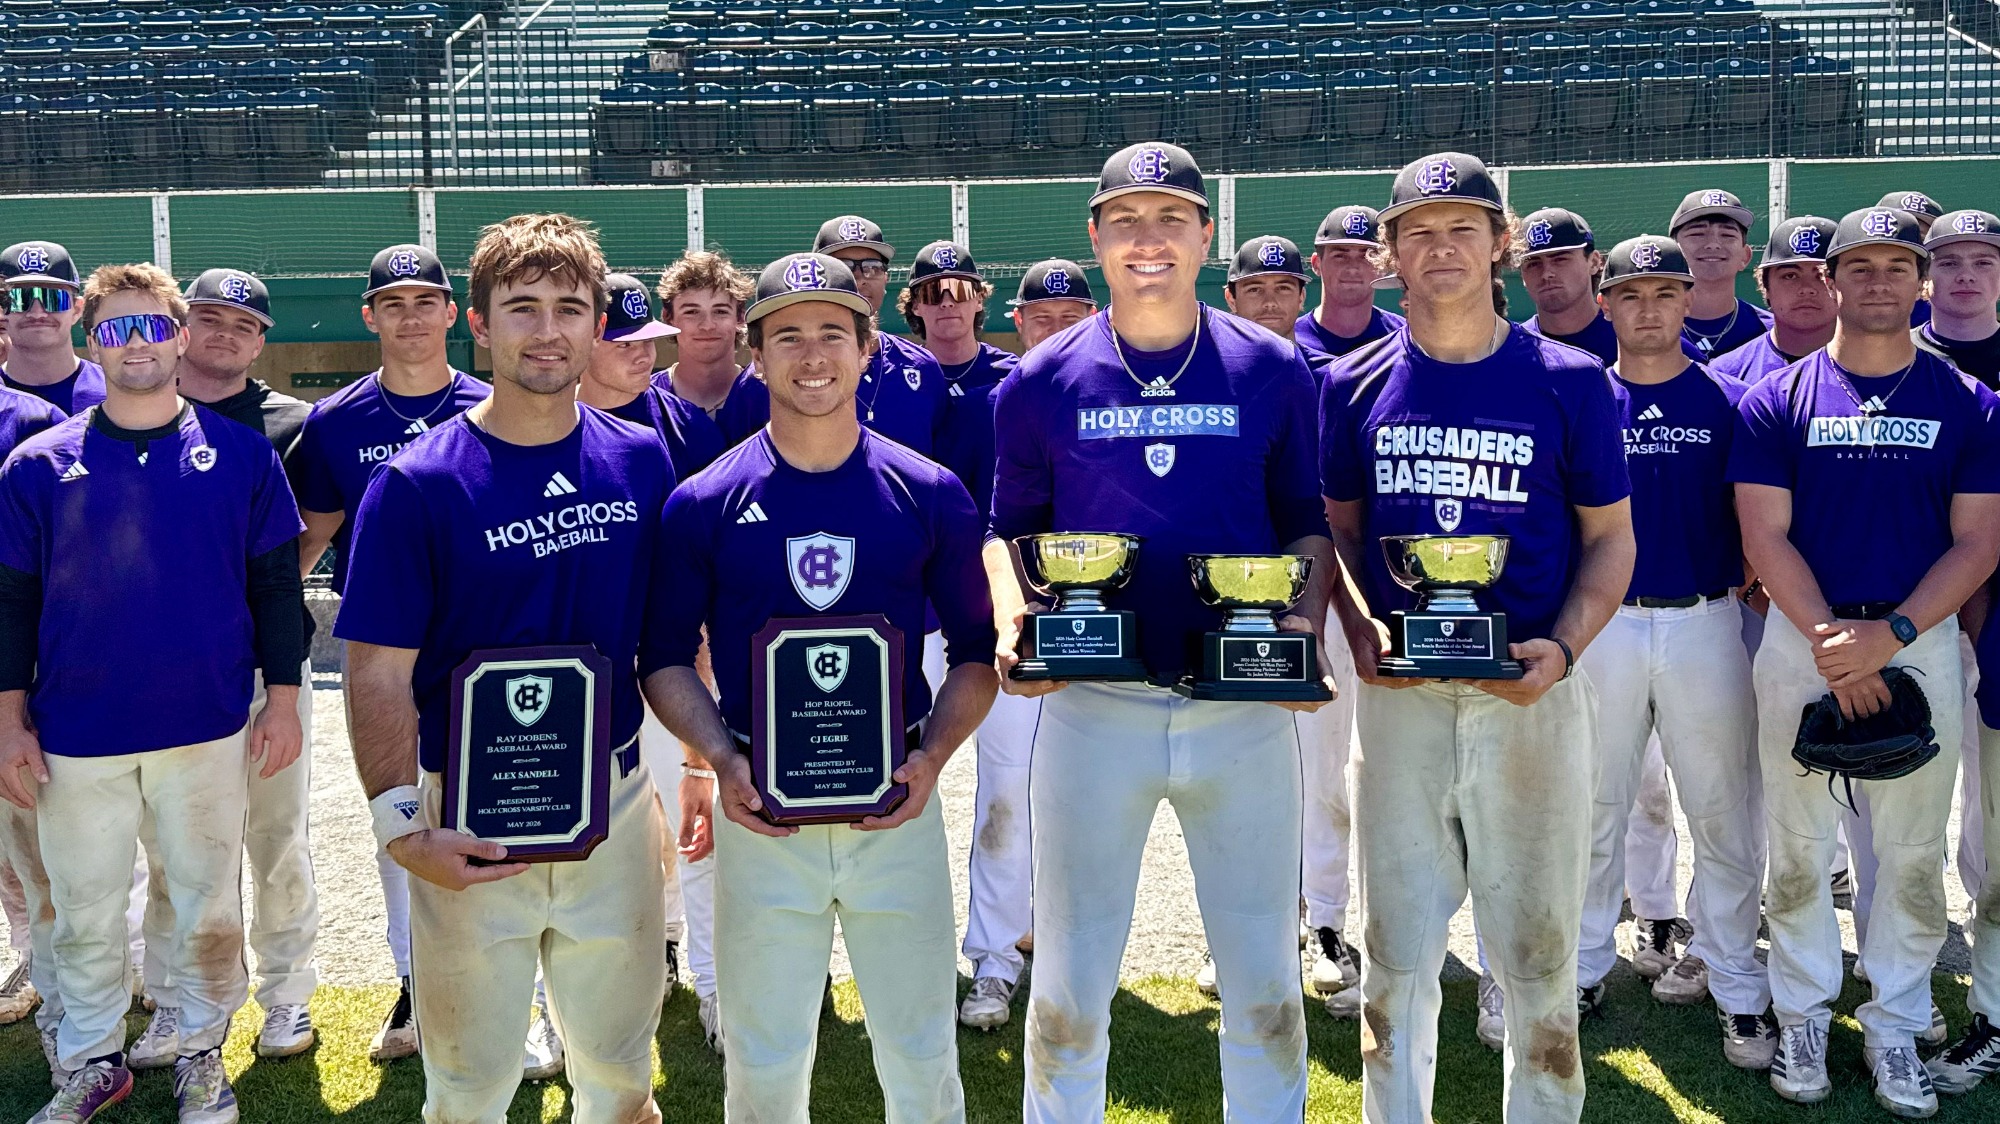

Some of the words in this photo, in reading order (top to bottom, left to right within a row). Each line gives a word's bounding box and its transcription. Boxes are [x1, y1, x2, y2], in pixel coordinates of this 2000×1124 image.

[1141, 388, 1176, 397] adidas
[1080, 408, 1143, 430] HOLY
[1151, 406, 1236, 427] CROSS
[1119, 427, 1194, 435] BASEBALL
[1622, 428, 1644, 443] LY
[1650, 425, 1712, 444] CROSS
[1817, 419, 1866, 442] HOLY
[1870, 419, 1930, 445] CROSS
[1375, 425, 1534, 466] CRUSADERS
[1623, 442, 1680, 454] BASEBALL
[1375, 459, 1529, 503] BASEBALL
[484, 511, 557, 552] HOLY
[557, 500, 639, 530] CROSS
[533, 526, 610, 558] BAEBALL
[496, 735, 517, 743] RAY
[518, 733, 558, 742] DOBENS
[810, 735, 821, 743] CJ
[822, 734, 849, 743] EGRIE
[486, 744, 532, 753] BASEBALL
[534, 743, 567, 751] AWARD
[492, 771, 516, 780] ALEX
[518, 769, 560, 779] SANDELL
[393, 800, 420, 810] adidas
[497, 797, 540, 805] PRESENTED
